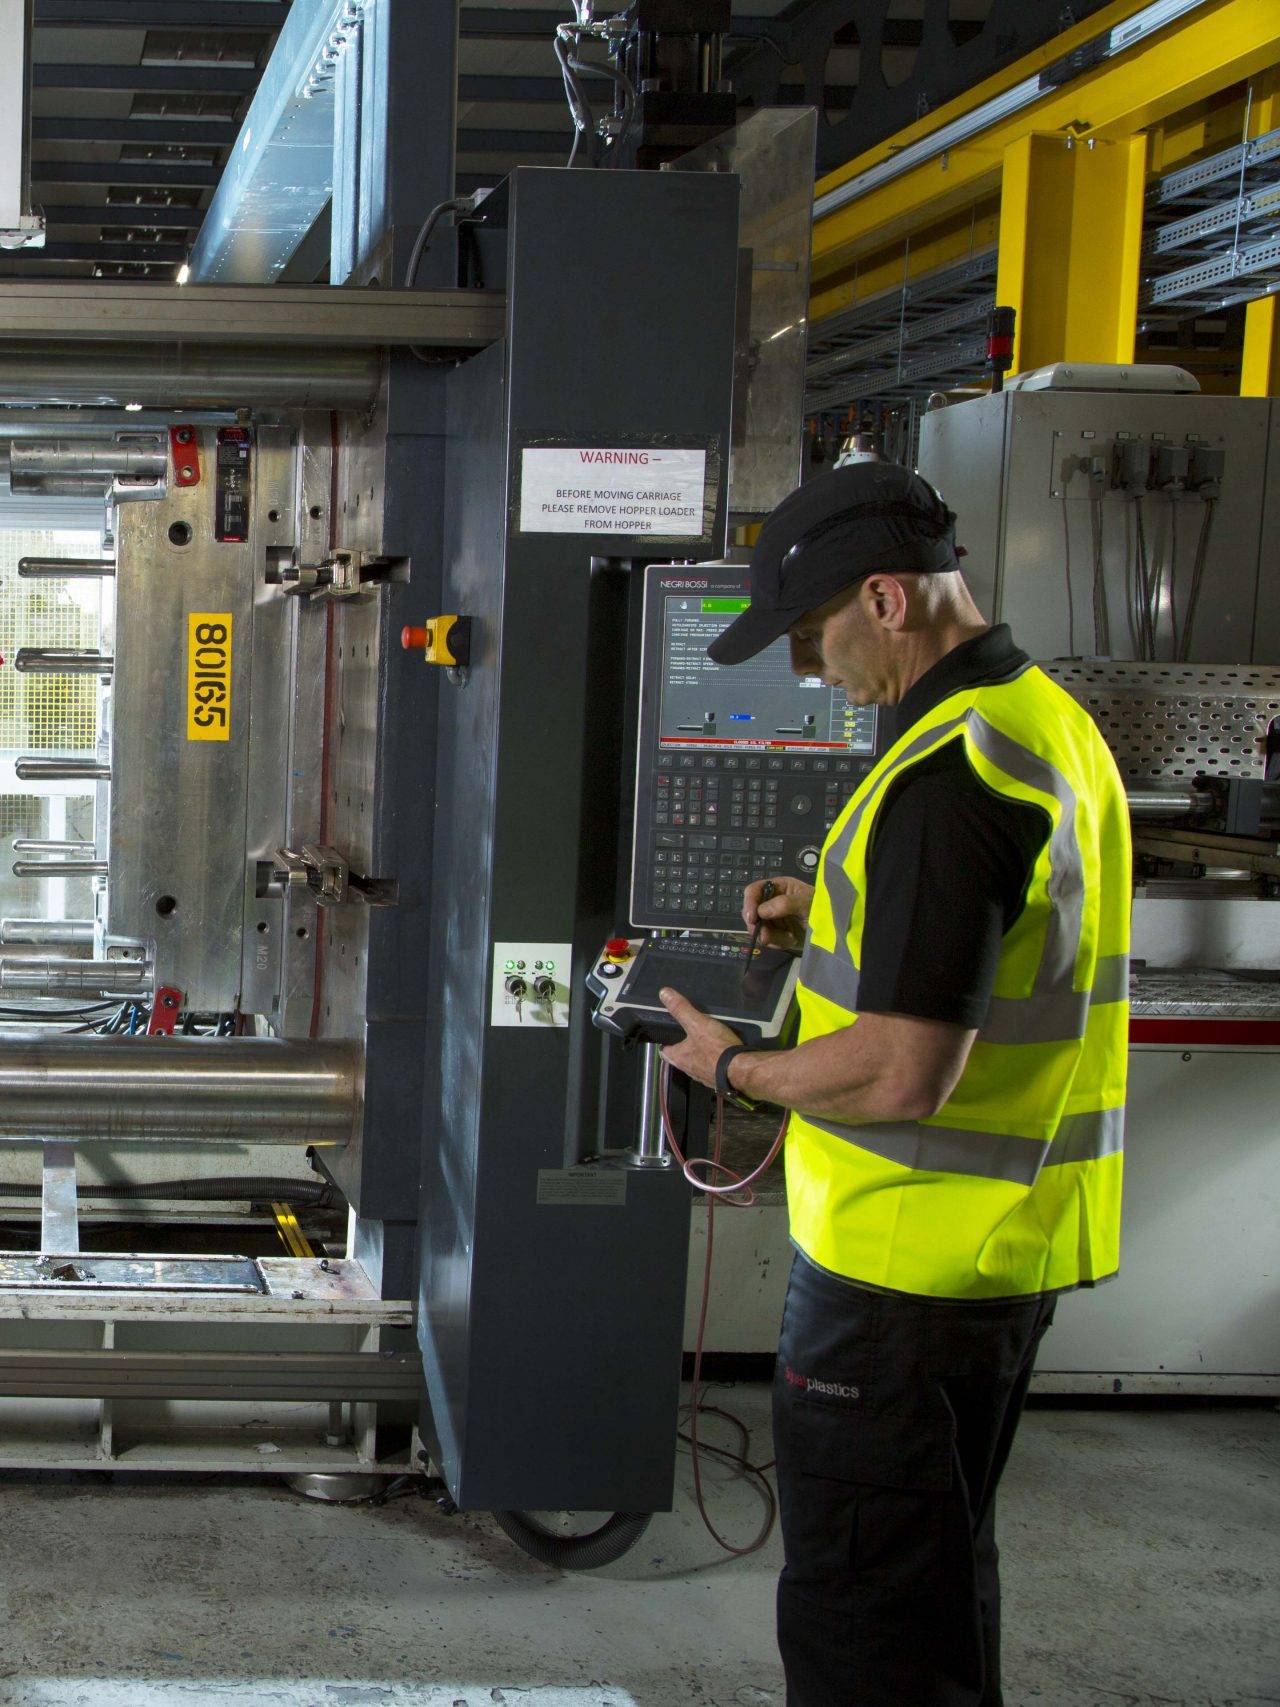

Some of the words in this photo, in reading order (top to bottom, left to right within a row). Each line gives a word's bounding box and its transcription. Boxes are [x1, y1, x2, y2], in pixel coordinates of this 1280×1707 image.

[579, 450, 649, 465] WARNING
[556, 489, 591, 499] BEFORE
[594, 490, 634, 500] MOVING
[636, 491, 682, 501] CARRIAGE
[541, 503, 575, 513] PLEASE
[577, 504, 617, 514] REMOVE
[619, 505, 656, 515] HOPPER
[658, 506, 695, 516] LOADER
[584, 519, 612, 529] FROM
[614, 520, 652, 530] HOPPER
[660, 580, 684, 589] NEGRI
[685, 580, 708, 589] BOSSI
[193, 622, 227, 728] 80165
[256, 945, 269, 970] M20
